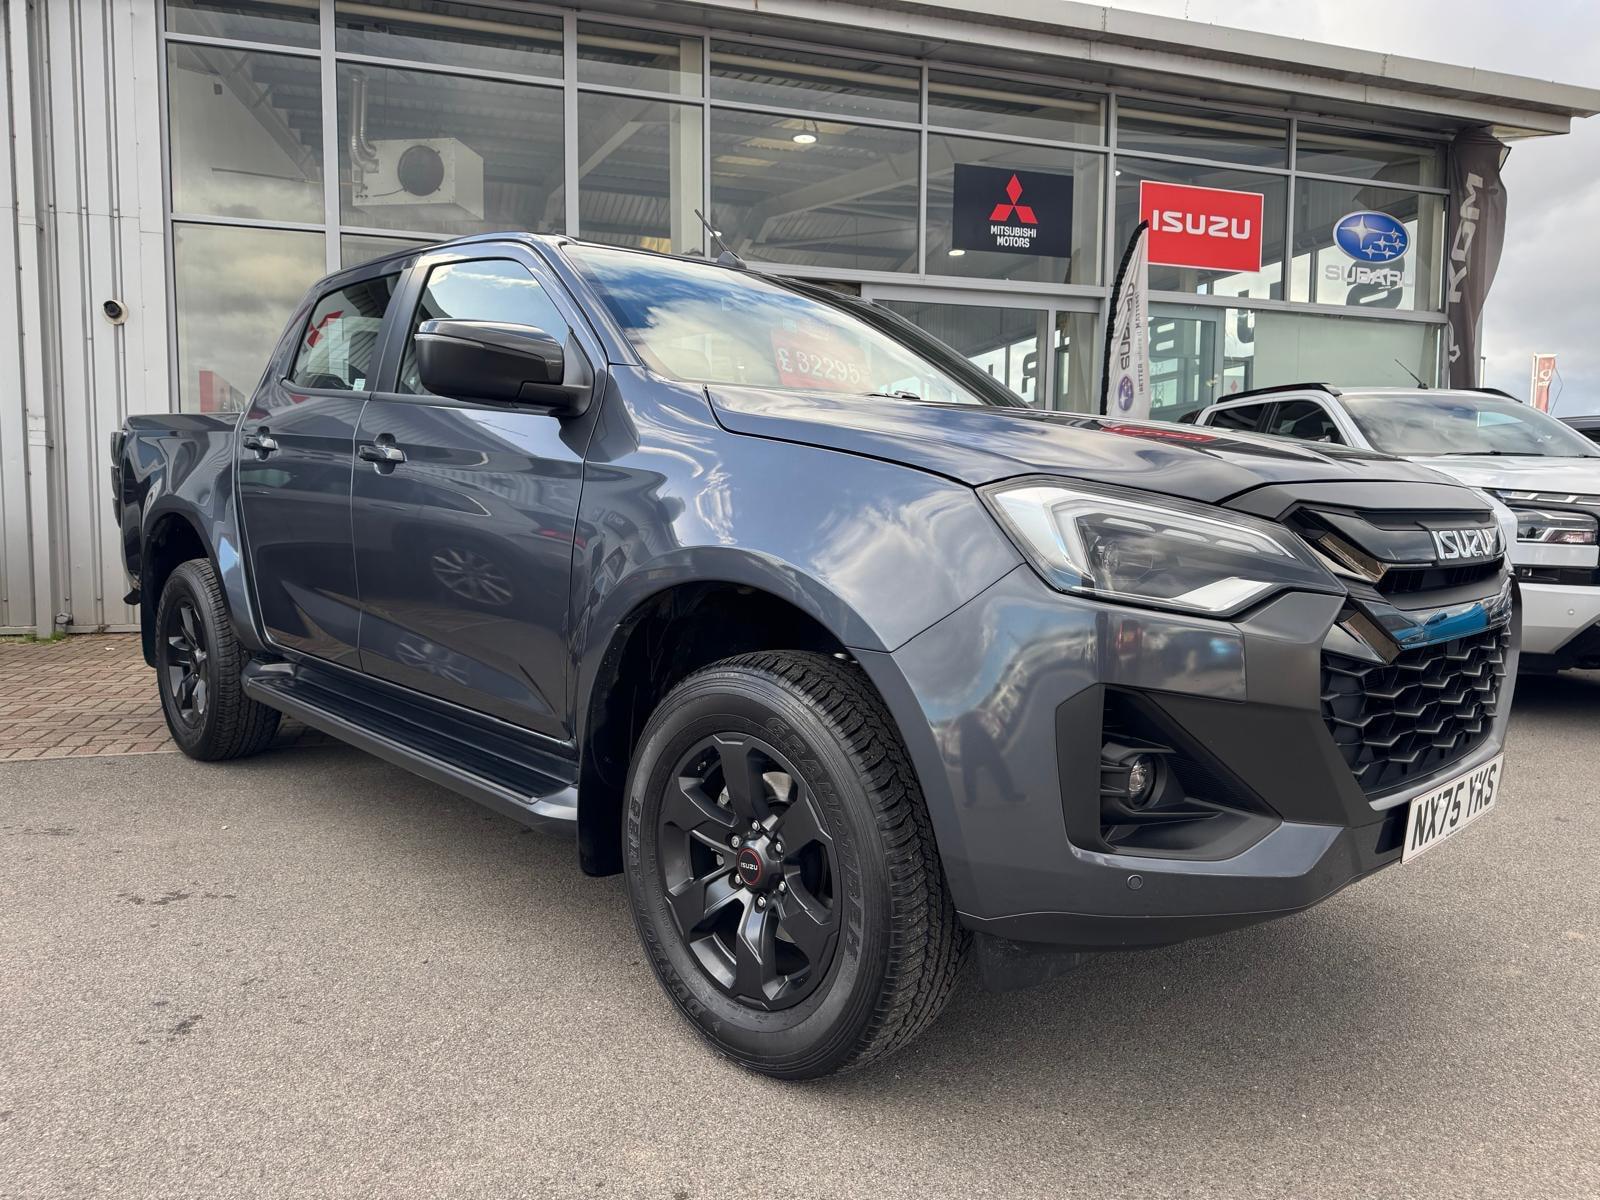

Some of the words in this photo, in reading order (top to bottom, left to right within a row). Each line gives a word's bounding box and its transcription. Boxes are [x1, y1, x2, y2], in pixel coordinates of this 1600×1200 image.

[990, 225, 1037, 239] MITSUBISHI
[1151, 209, 1251, 240] ISUZU
[996, 236, 1030, 248] MOTORS
[1325, 264, 1414, 289] SUBARU
[1431, 529, 1493, 559] ISUZU
[1411, 781, 1465, 851] NX75
[740, 861, 758, 871] ISUZU
